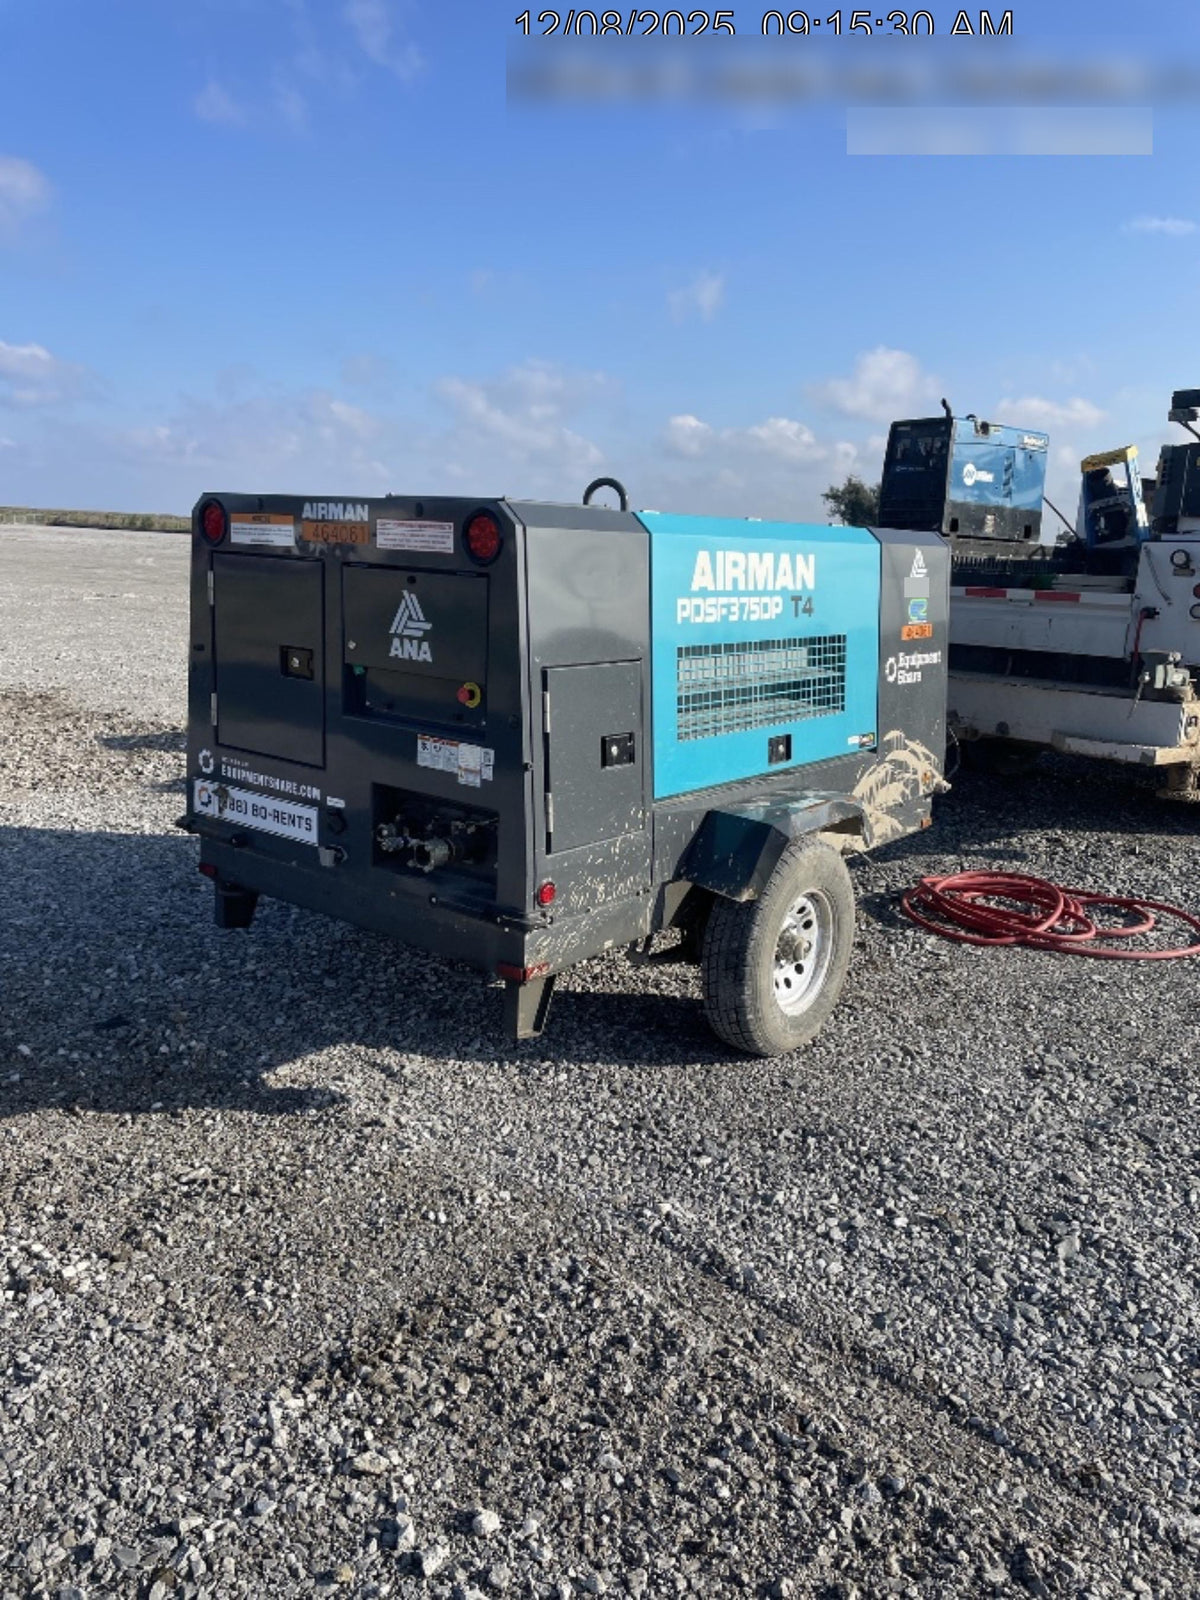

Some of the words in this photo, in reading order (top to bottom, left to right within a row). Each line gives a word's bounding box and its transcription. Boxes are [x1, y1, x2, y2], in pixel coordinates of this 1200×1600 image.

[301, 502, 369, 522] AIRMAN
[690, 550, 815, 592] AIRMAN
[790, 595, 815, 618] T4
[389, 637, 433, 663] ANA
[221, 764, 321, 801] EQUIPMENTSHARE.COM
